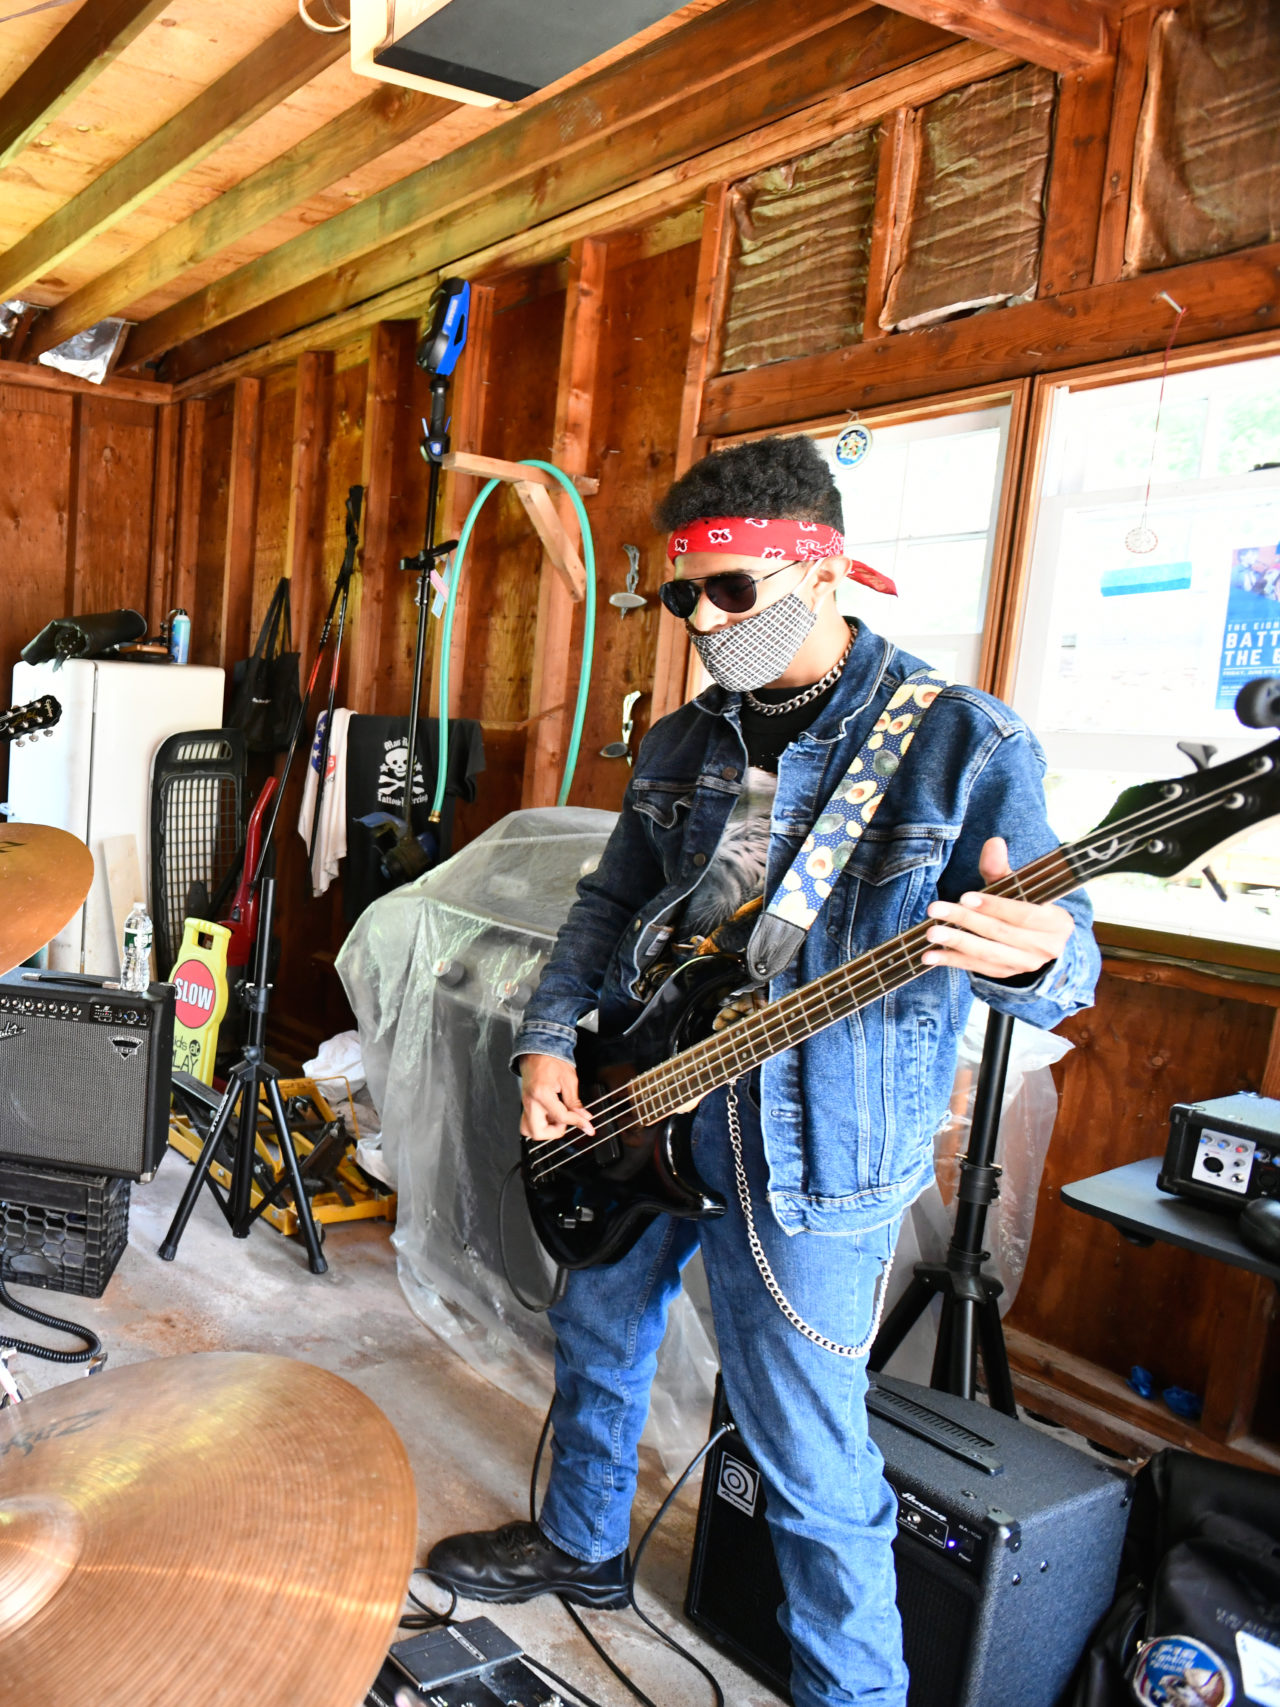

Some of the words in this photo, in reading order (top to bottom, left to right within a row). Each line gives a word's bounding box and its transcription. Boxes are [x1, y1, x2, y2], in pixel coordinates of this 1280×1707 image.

[1224, 649, 1262, 666] THE
[174, 977, 214, 1011] SLOW
[173, 1034, 188, 1051] ids
[172, 1049, 199, 1075] LAY
[901, 1492, 947, 1521] Ampeg
